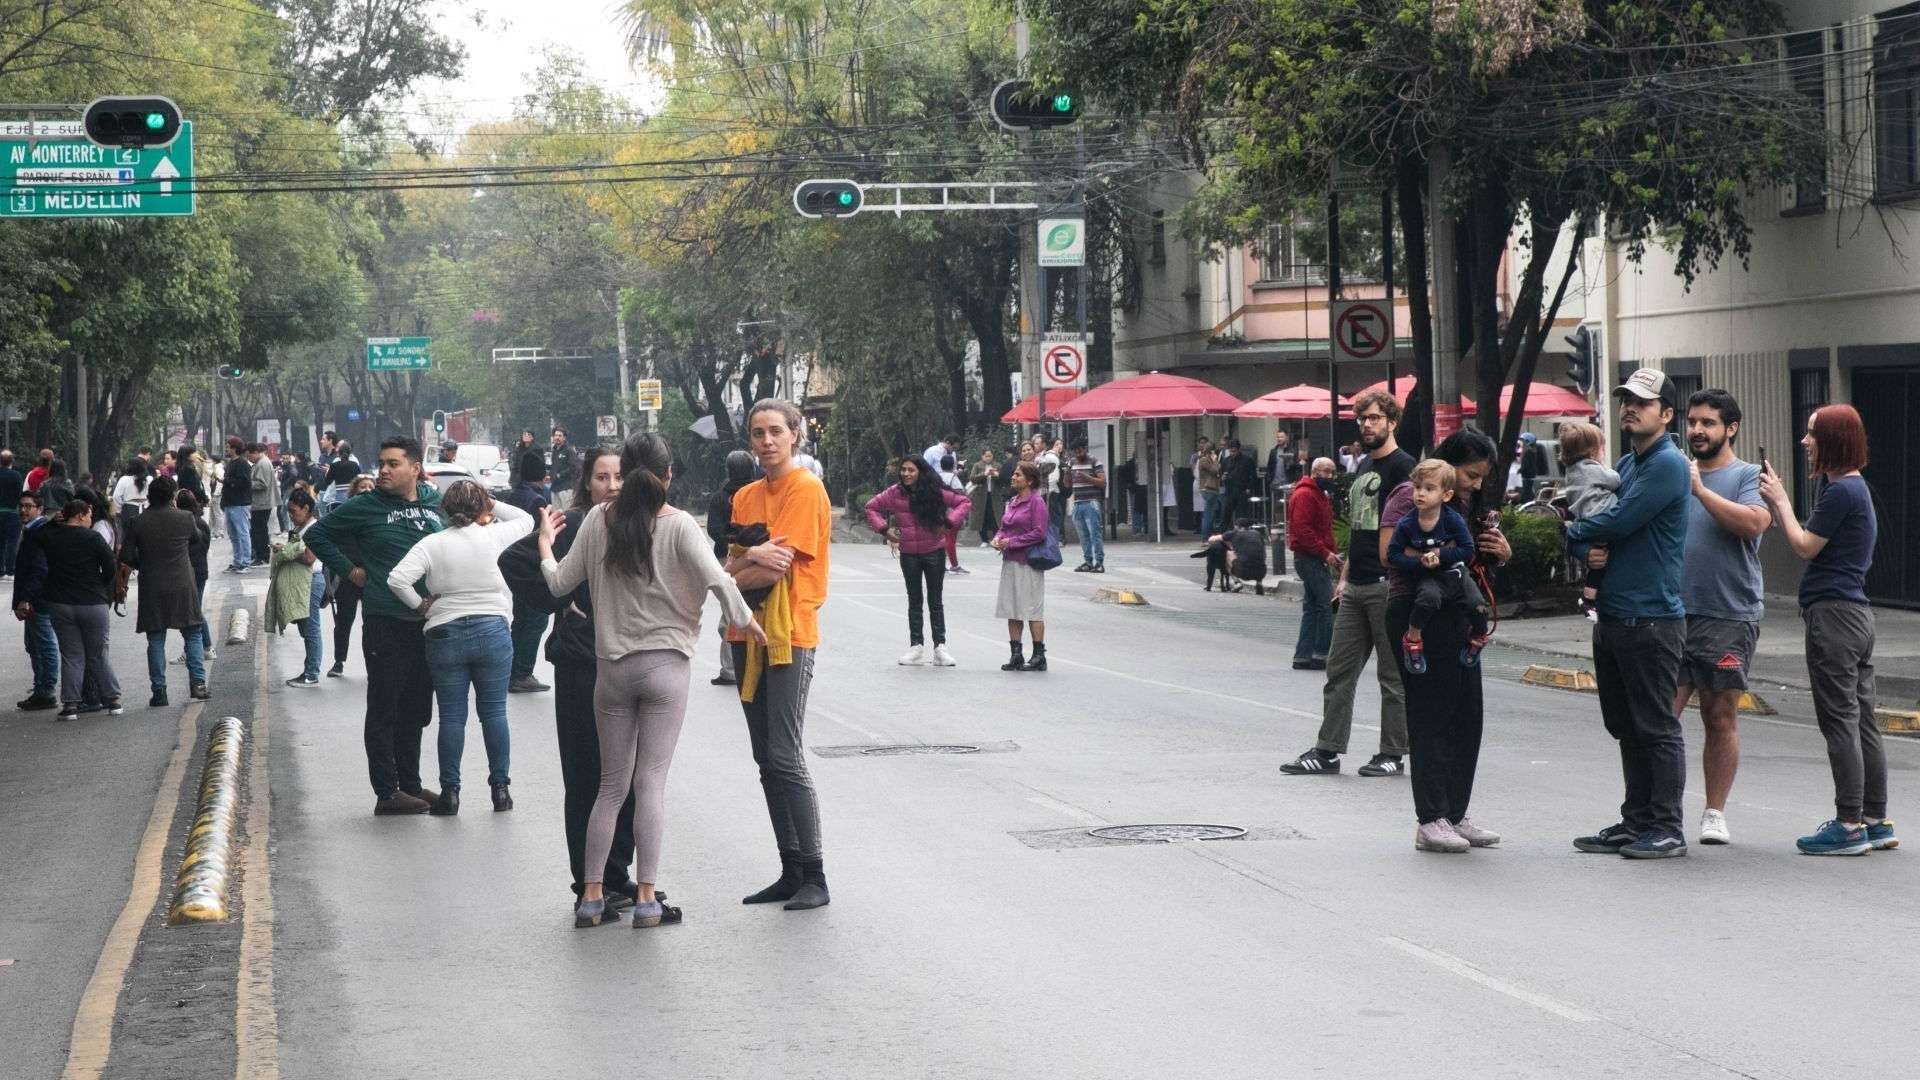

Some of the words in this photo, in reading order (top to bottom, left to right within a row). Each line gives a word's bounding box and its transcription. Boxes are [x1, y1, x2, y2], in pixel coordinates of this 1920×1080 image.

[6, 125, 30, 134] EJE
[42, 125, 48, 134] 2
[10, 146, 26, 163] AV
[32, 145, 105, 163] MONTERREY
[23, 171, 65, 182] PARQUE
[71, 169, 112, 182] ESPAÑA
[17, 193, 27, 206] 3
[398, 347, 427, 355] SONOR
